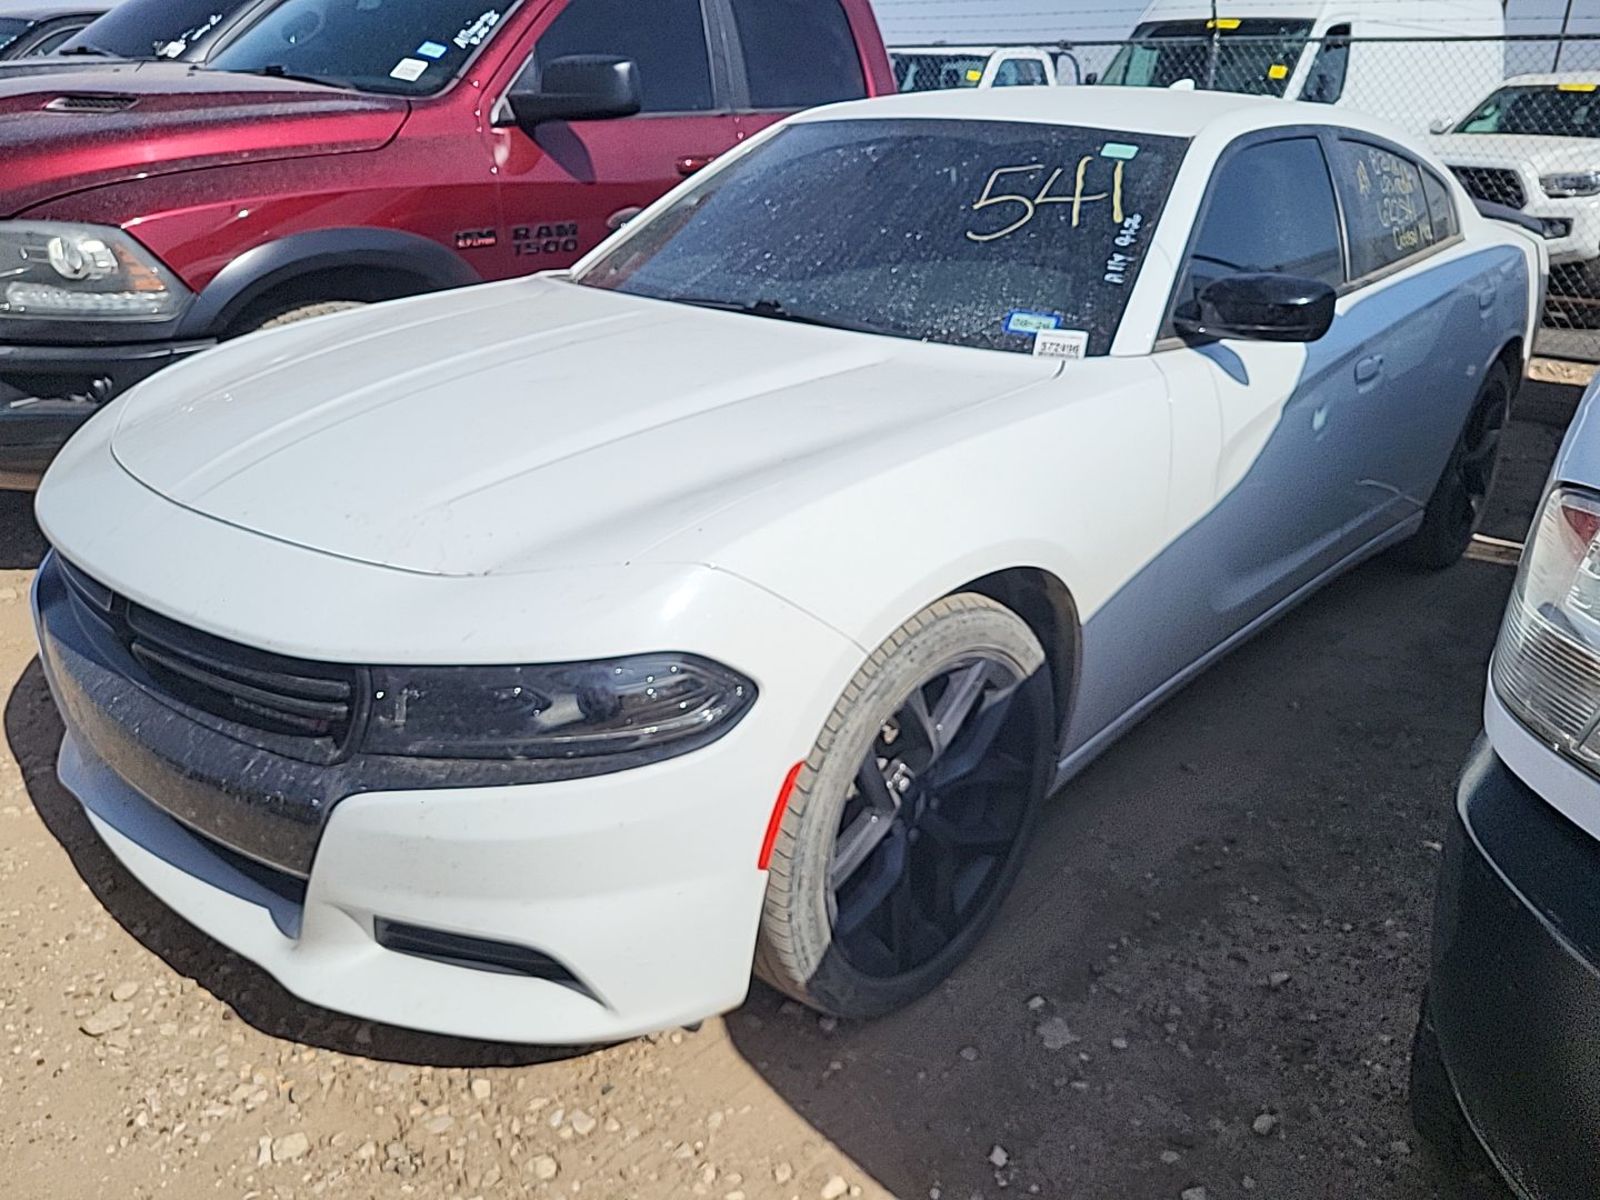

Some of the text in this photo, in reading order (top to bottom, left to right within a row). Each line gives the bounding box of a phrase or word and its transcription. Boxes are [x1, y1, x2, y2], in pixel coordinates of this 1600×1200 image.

[967, 156, 1124, 241] 541
[512, 223, 578, 241] RAM
[513, 239, 578, 256] 1500
